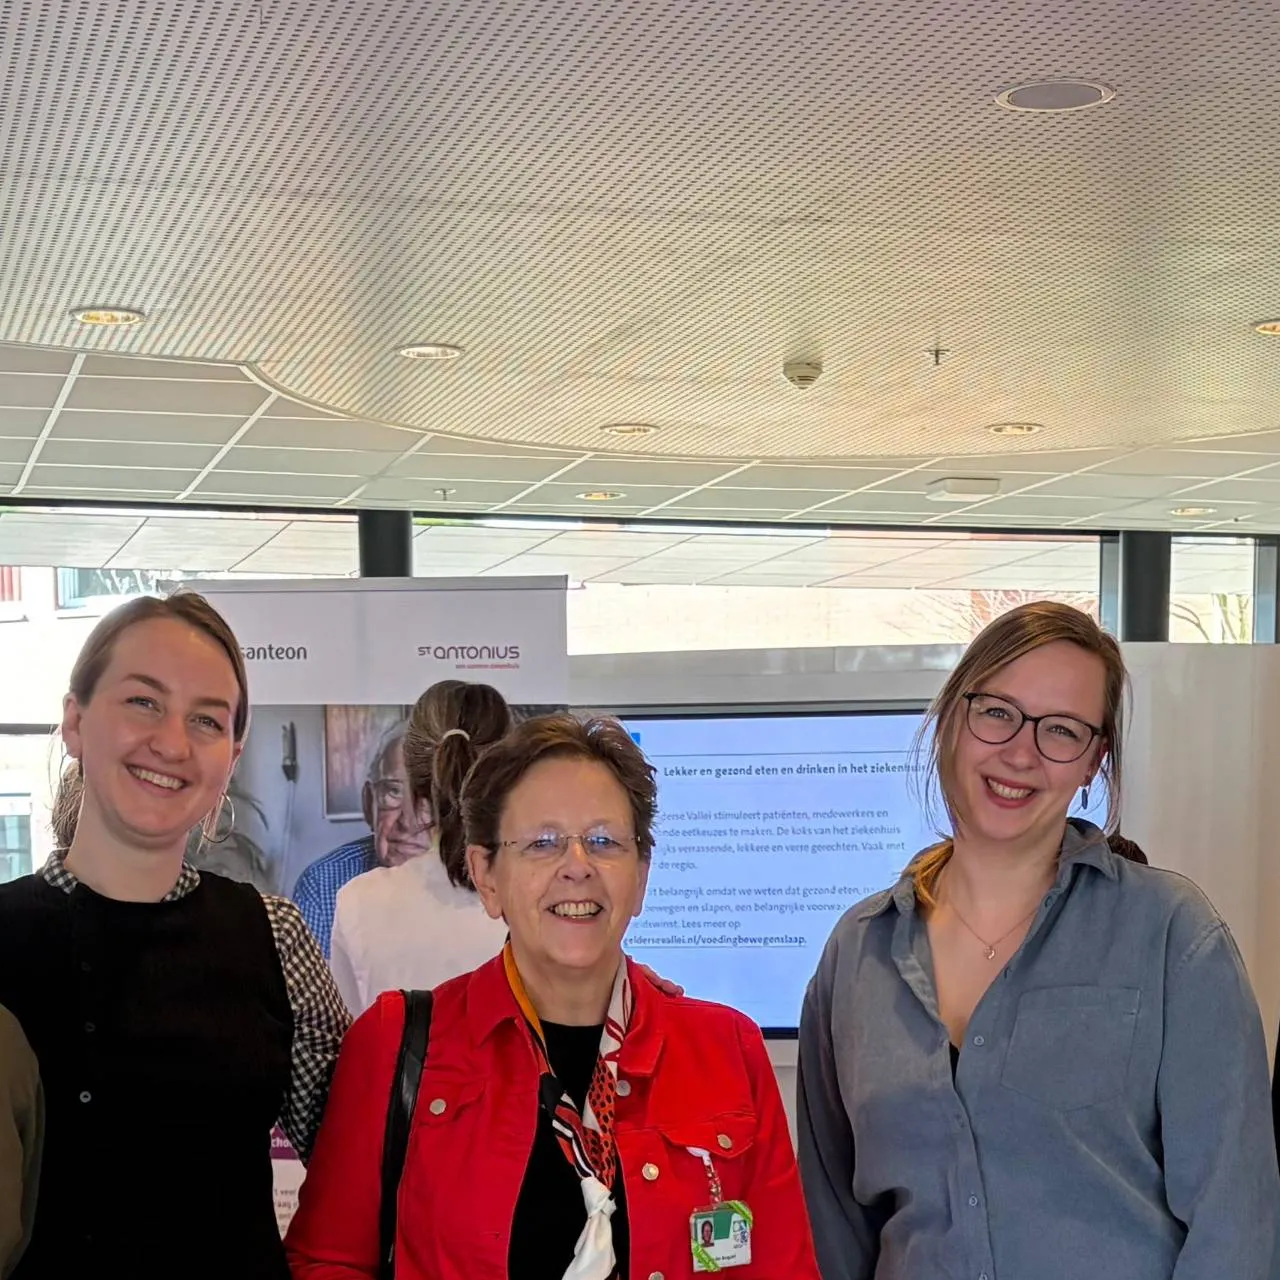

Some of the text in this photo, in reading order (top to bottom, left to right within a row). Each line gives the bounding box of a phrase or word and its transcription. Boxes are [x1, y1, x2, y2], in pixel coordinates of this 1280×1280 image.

[663, 765, 697, 777] Lekker
[699, 767, 713, 777] en
[714, 764, 752, 778] gezond
[755, 765, 778, 776] eten
[781, 766, 794, 776] en
[796, 763, 836, 775] drinken
[838, 763, 848, 774] in
[850, 762, 868, 774] het
[876, 809, 888, 819] en
[851, 824, 901, 836] ziekenhuis
